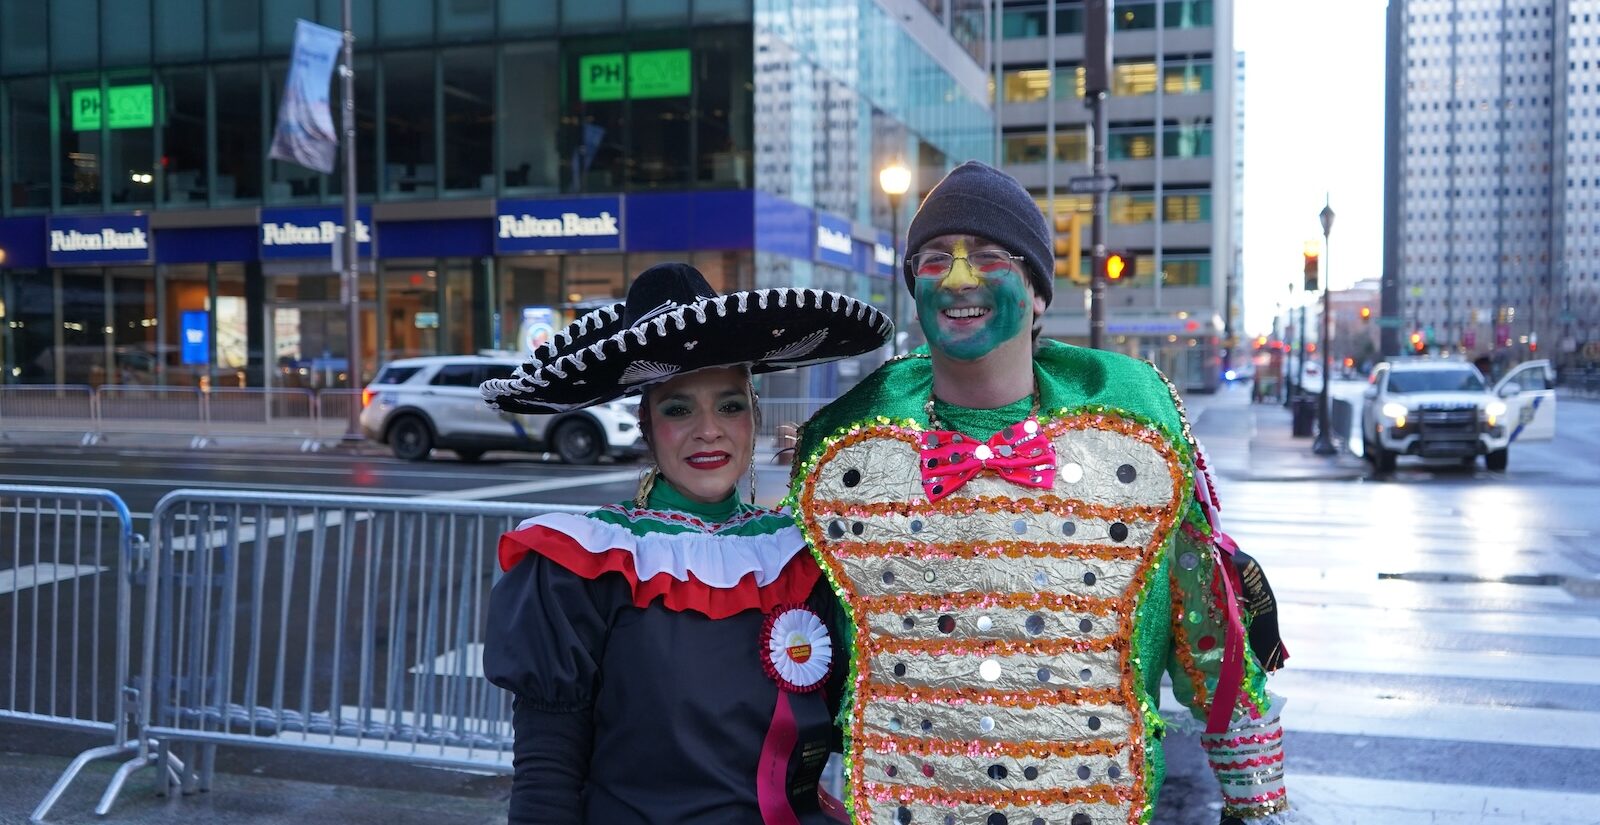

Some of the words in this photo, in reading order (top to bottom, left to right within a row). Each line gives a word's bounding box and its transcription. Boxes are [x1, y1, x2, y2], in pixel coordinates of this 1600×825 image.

[263, 222, 320, 245] Fulton
[498, 213, 562, 238] Fulton
[562, 211, 619, 235] Bank
[51, 229, 102, 251] Fulton
[102, 227, 147, 249] Bank
